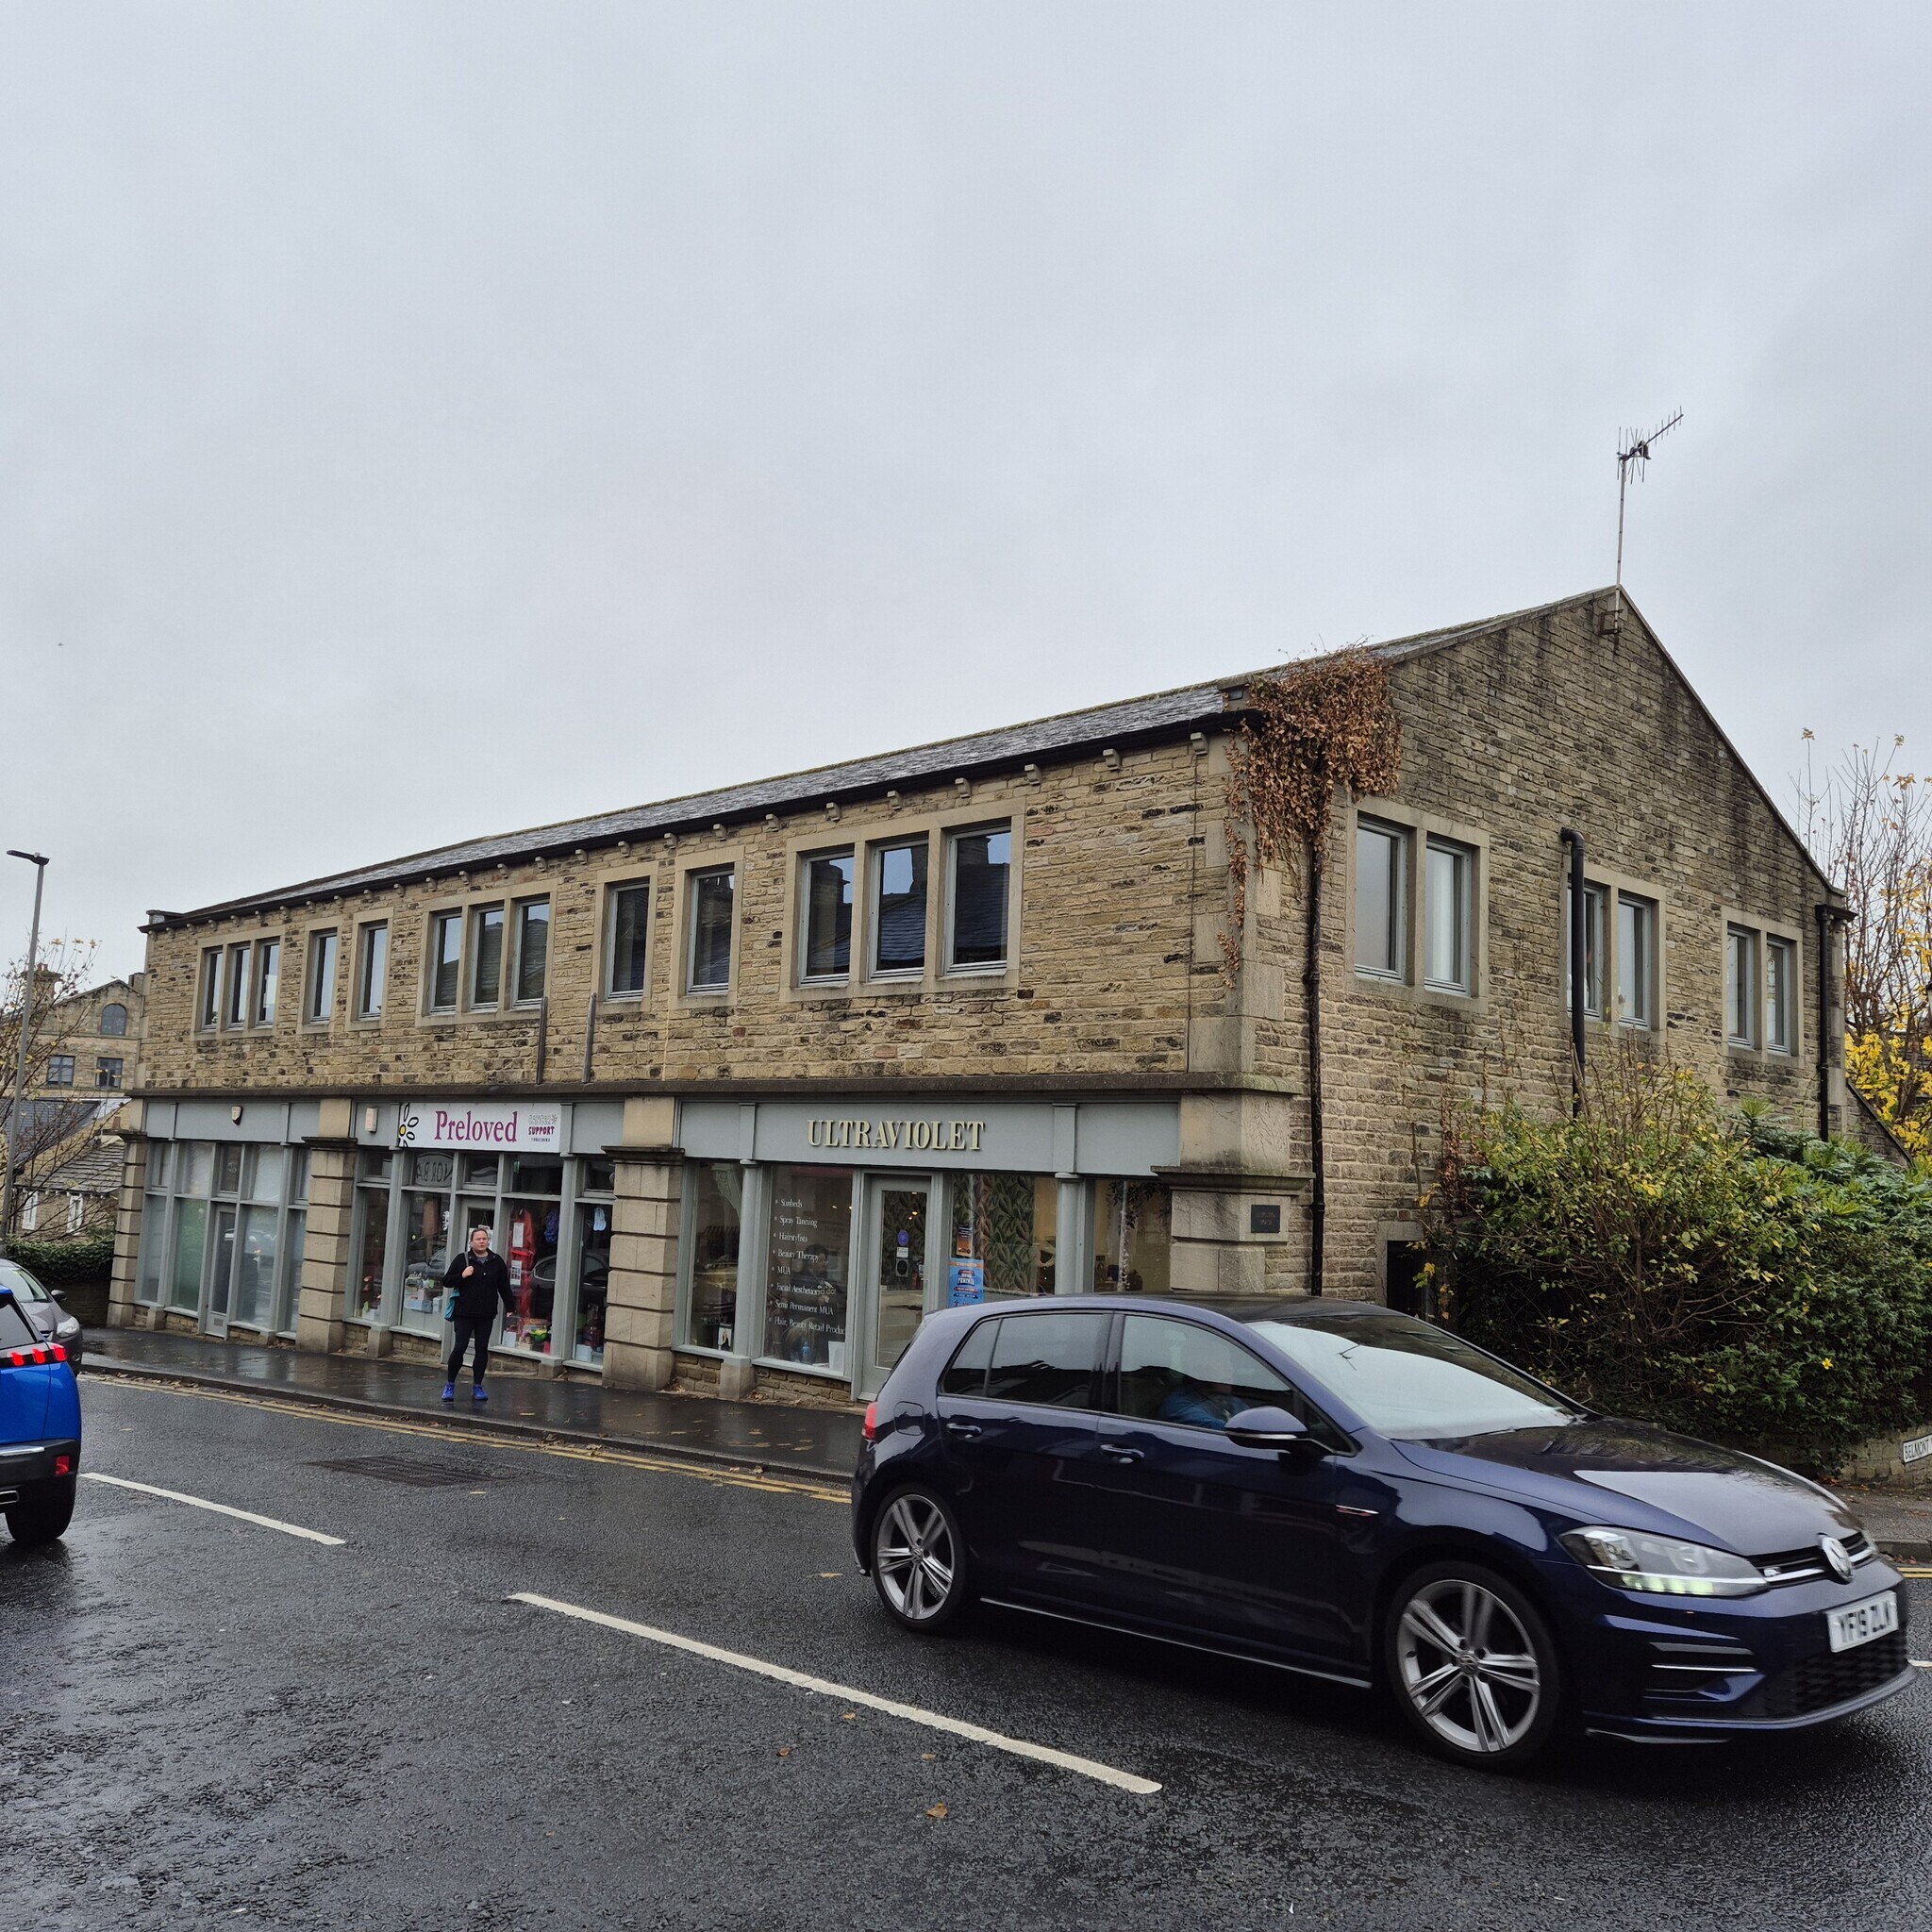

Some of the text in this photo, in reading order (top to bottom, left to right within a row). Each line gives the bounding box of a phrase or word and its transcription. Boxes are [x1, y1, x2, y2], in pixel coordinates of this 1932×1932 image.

[435, 1110, 518, 1142] Preloved
[528, 1125, 555, 1136] SUPPORT
[808, 1119, 984, 1150] ULTRAVIOLET
[780, 1198, 803, 1208] Sunbeds
[779, 1214, 818, 1229] Spray Tanning
[777, 1249, 819, 1263] Beauty Therapy
[777, 1266, 791, 1274] MUA
[776, 1282, 791, 1291] Facial
[774, 1300, 834, 1316] Semi Permanent MUA
[789, 1319, 808, 1331] Beauty
